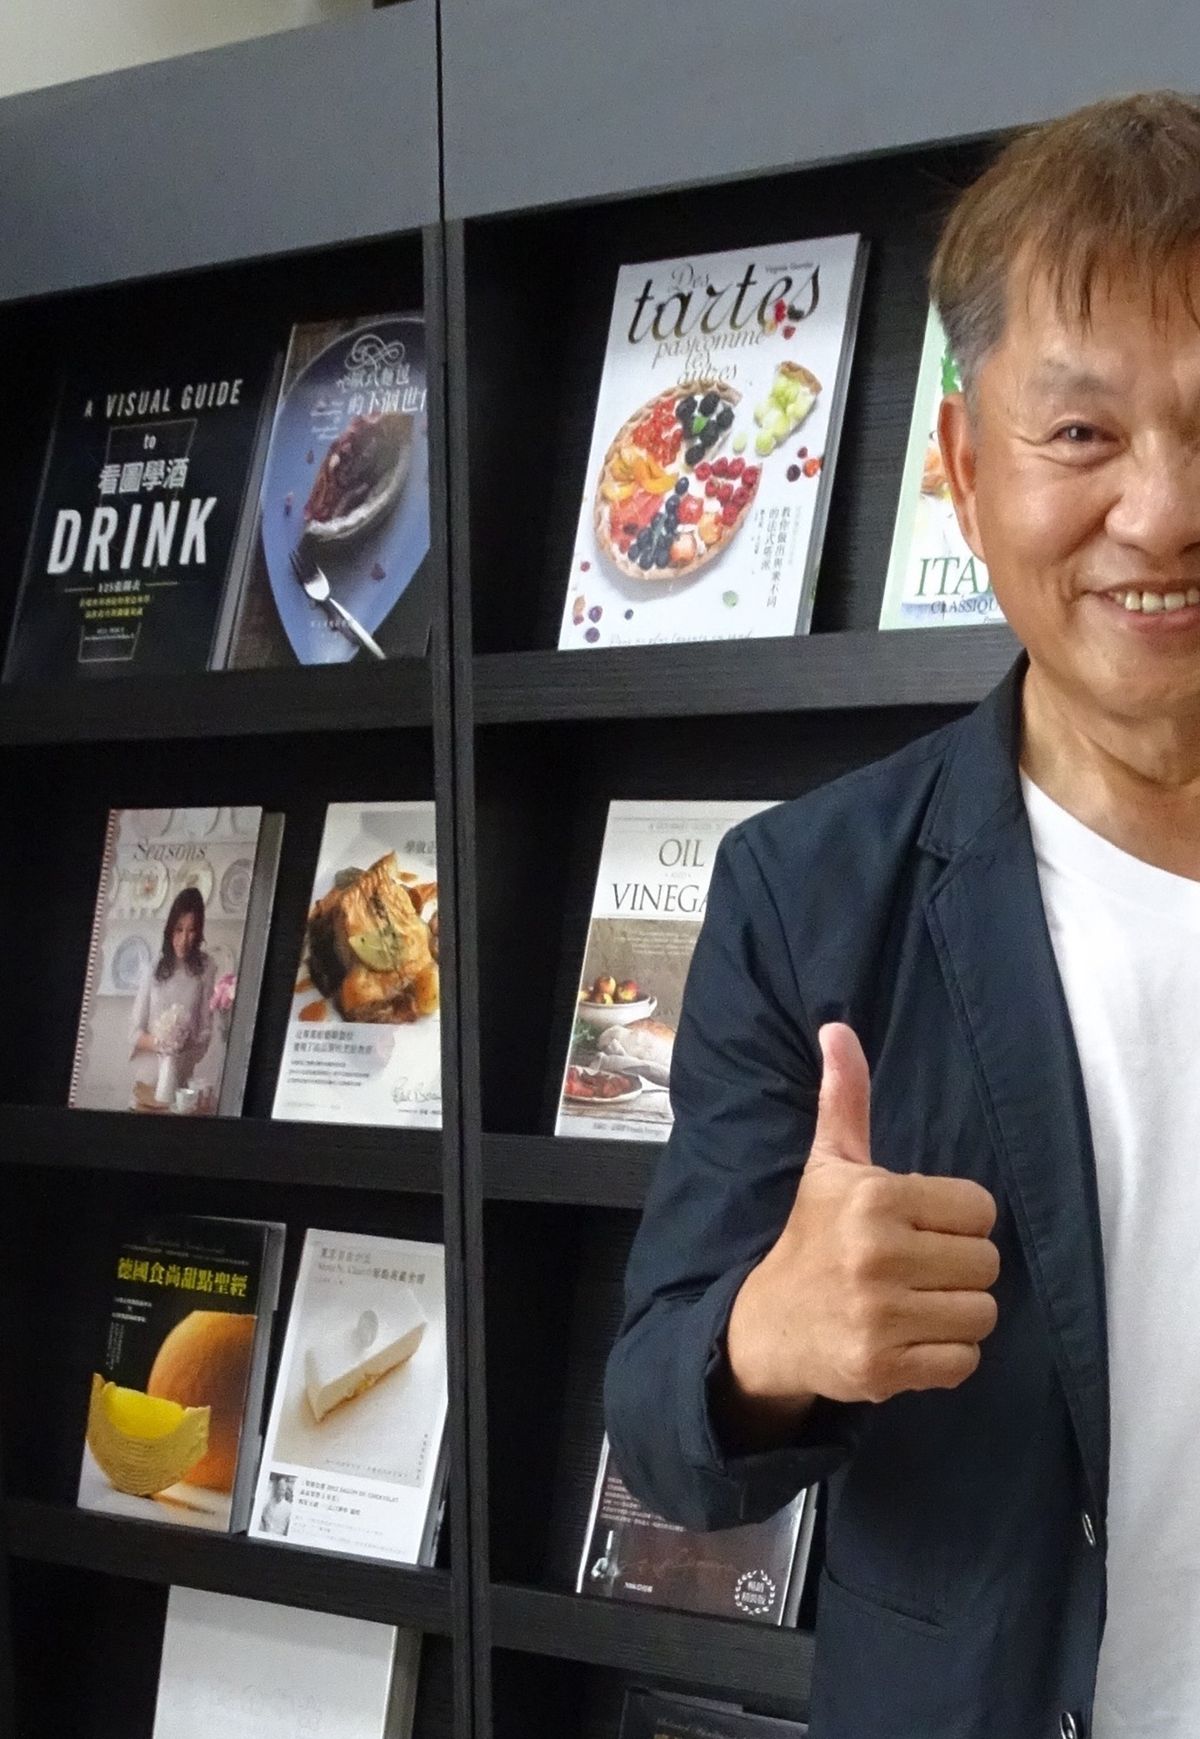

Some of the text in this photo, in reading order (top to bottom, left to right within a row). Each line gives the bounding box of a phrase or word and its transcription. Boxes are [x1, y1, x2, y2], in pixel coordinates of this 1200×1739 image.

[626, 262, 821, 346] tartes
[84, 378, 244, 418] A VISUAL GUIDE
[143, 434, 157, 450] to
[98, 457, 190, 495] 看圖學酒
[47, 497, 217, 575] DRINK
[914, 556, 994, 597] ITA
[658, 838, 704, 867] OIL
